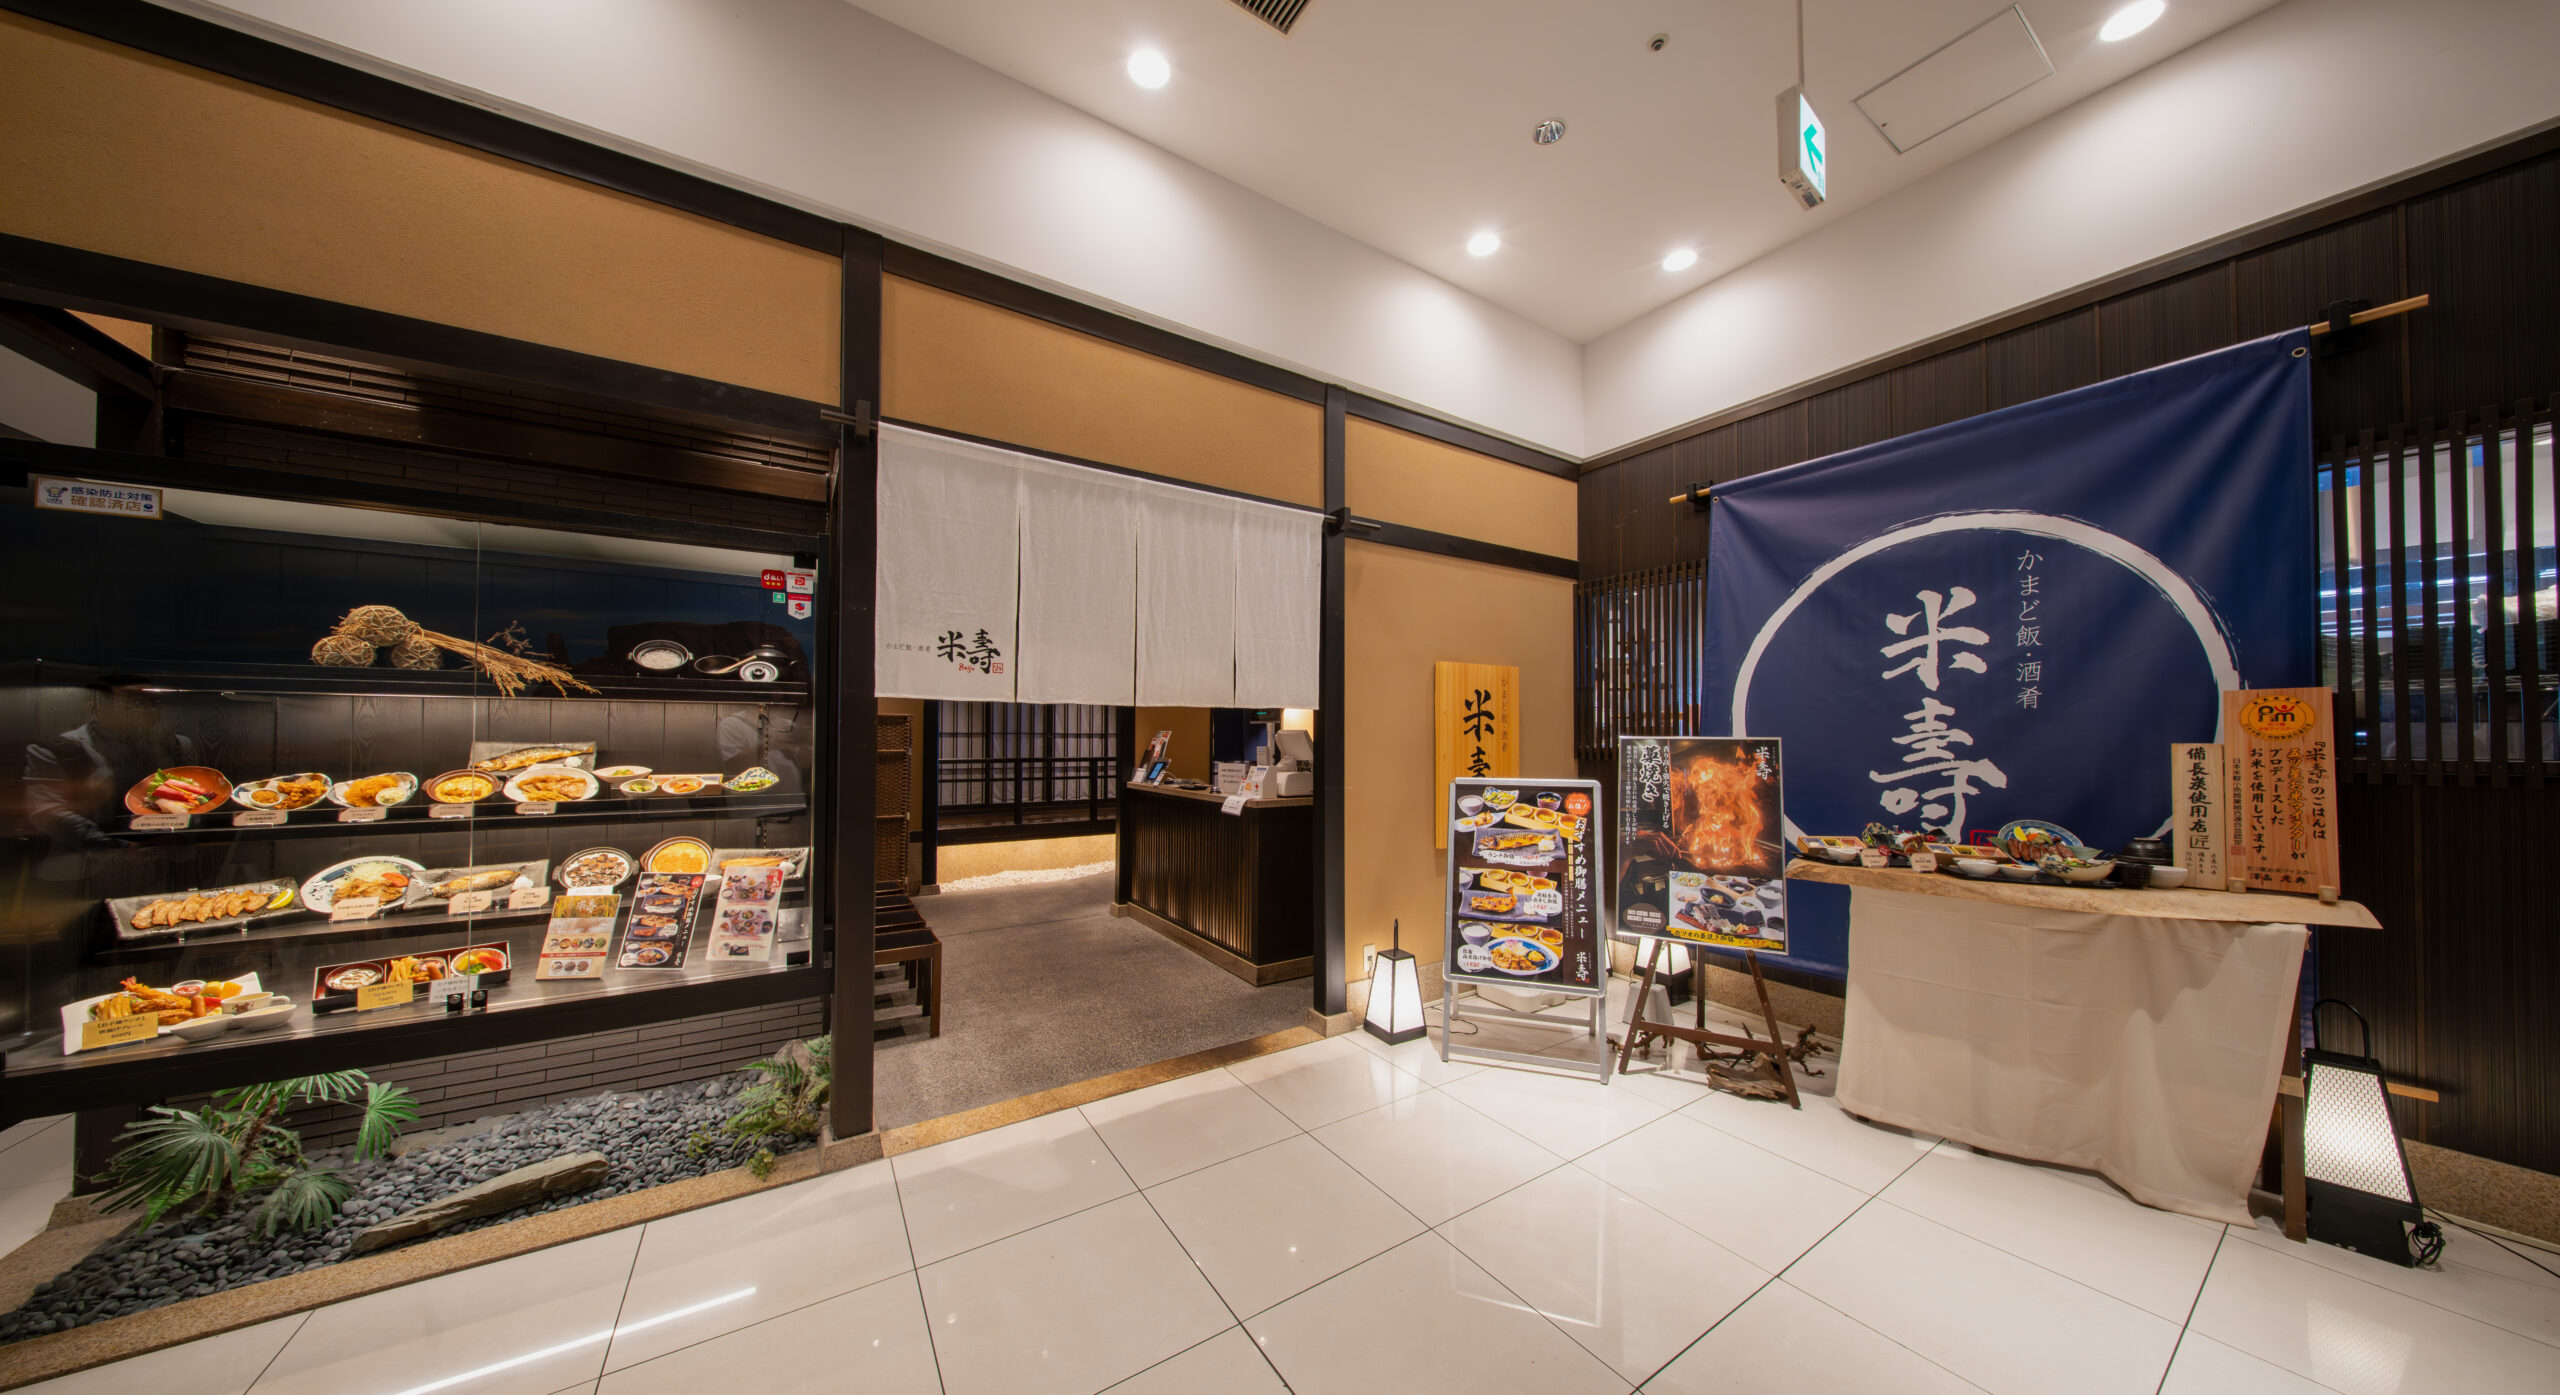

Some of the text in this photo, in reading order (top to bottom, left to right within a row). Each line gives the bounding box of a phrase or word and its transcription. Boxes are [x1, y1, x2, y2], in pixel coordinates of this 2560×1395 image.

[70, 494, 142, 512] 確認済店
[71, 486, 153, 502] 感染防止対策
[2016, 549, 2044, 710] かまど飯・酒肴
[2250, 747, 2267, 861] お米を使用しています。
[1573, 818, 1589, 940] おすすめ御膳メニュー
